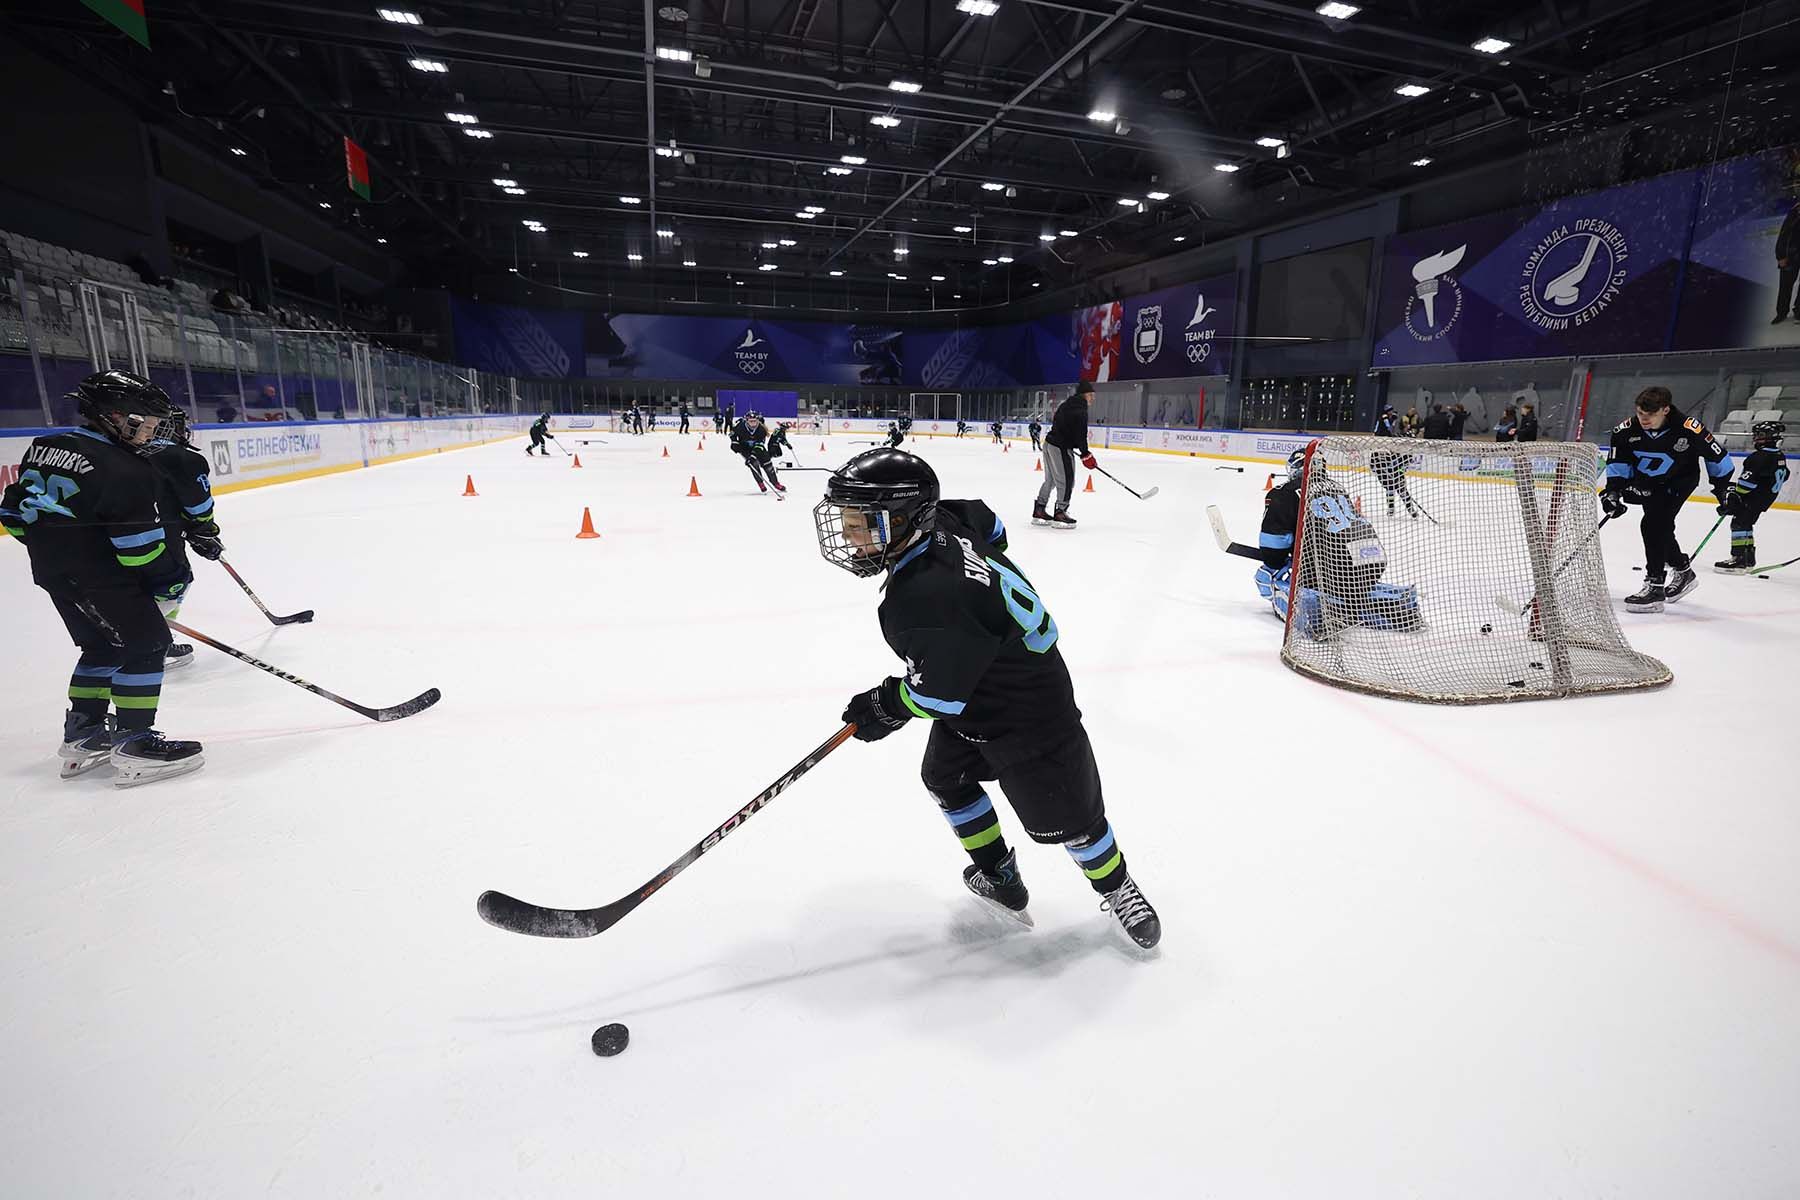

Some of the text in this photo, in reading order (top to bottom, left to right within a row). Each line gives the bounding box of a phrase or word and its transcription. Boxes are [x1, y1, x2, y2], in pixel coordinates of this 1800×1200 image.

[1522, 219, 1628, 277] КОМАНДА ПРЕЗИДЕНТА
[1520, 269, 1627, 330] РЕСПУБЛИКИ БЕЛАРУСЬ
[1184, 329, 1216, 342] TEAM BY
[734, 351, 769, 360] TEAM BY
[237, 433, 321, 459] БЕЛНЕФТЕХИМ
[892, 490, 920, 498] BAUER
[701, 772, 796, 853] SOYUZ
